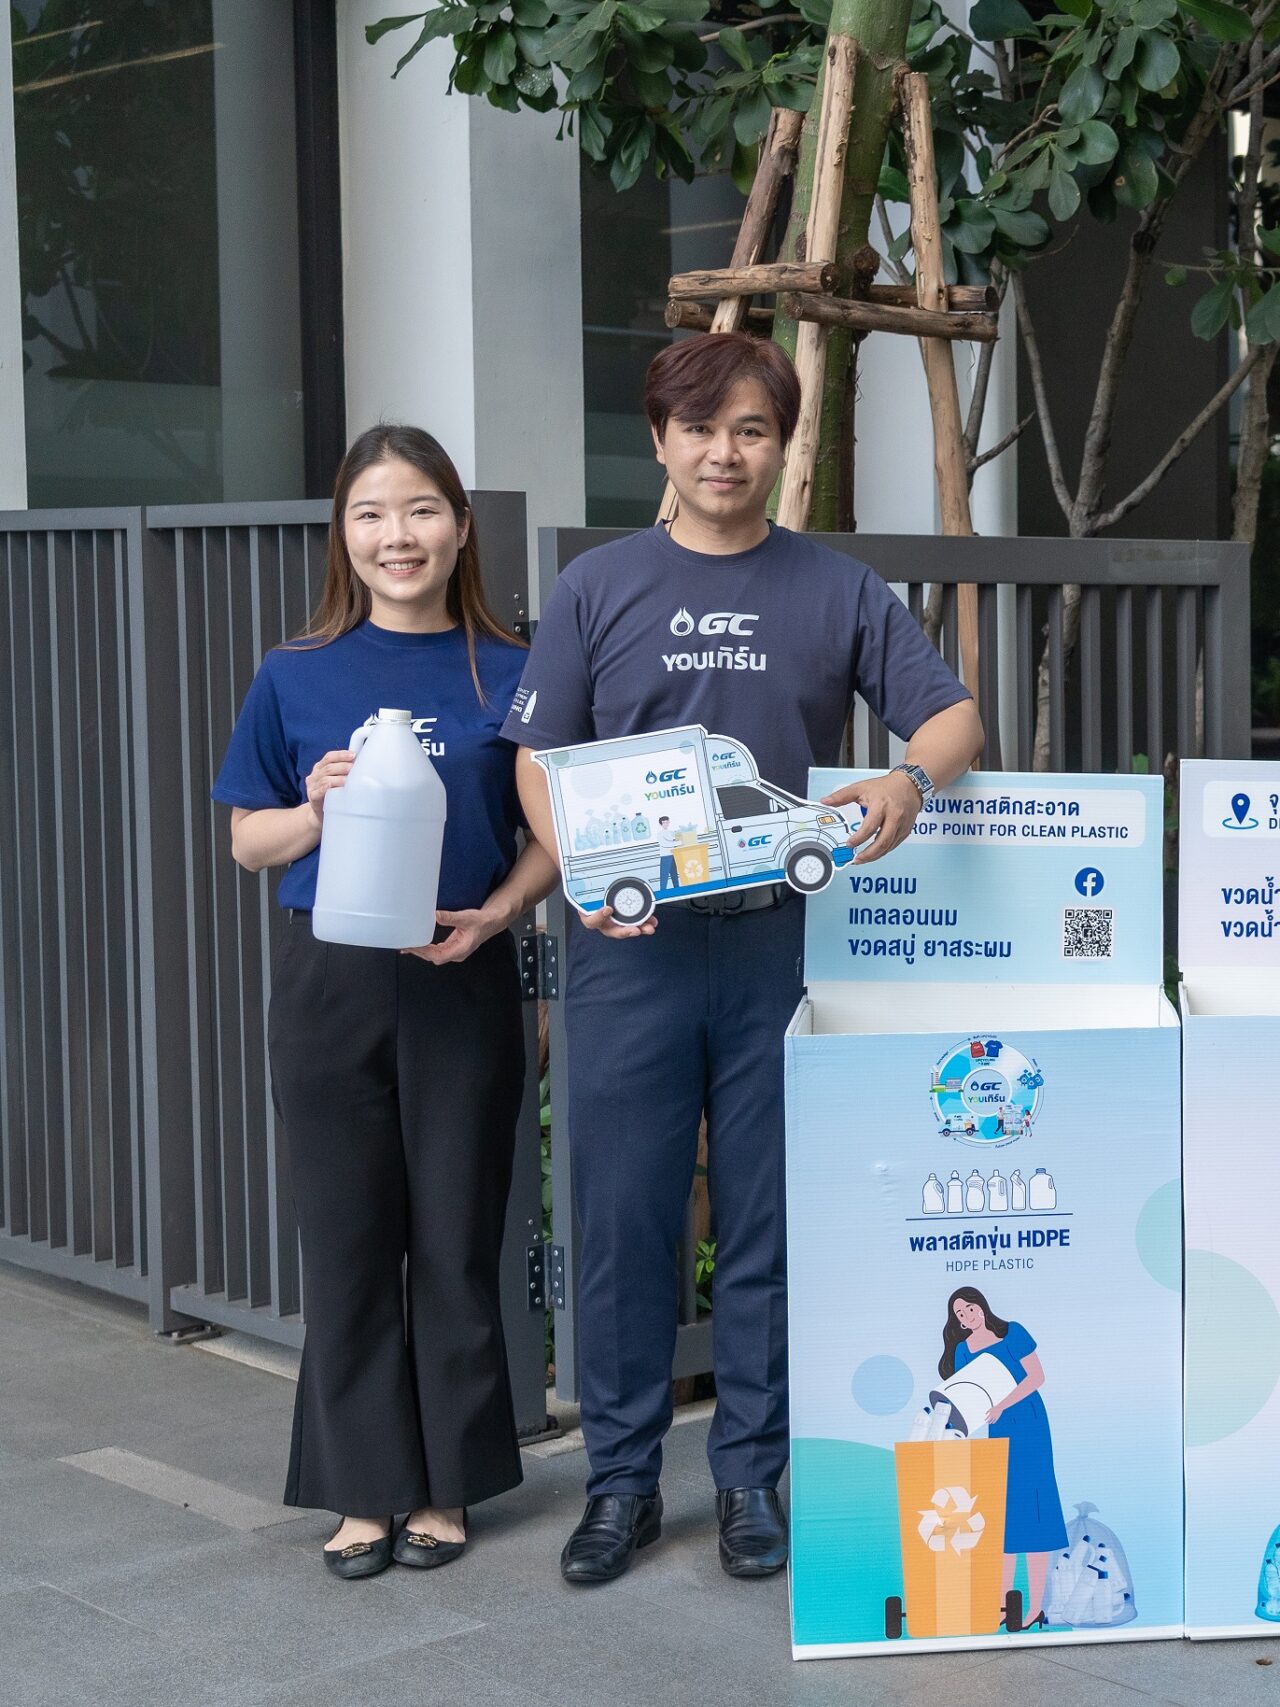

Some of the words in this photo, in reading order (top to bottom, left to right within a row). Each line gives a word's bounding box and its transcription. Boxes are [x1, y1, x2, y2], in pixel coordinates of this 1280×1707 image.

[697, 612, 760, 636] GC
[720, 751, 737, 761] GC
[659, 767, 687, 783] GC
[912, 822, 938, 836] ROP
[942, 822, 985, 836] POINT
[989, 823, 1017, 837] FOR
[1021, 824, 1066, 838] CLEAN
[1071, 825, 1129, 839] PLASTIC
[747, 833, 773, 848] GC
[849, 876, 917, 895] ขวดนม
[849, 907, 958, 926] แกลลอนนม
[848, 934, 916, 965] ขวดสบู่
[923, 938, 1012, 958] ยาสระผม
[979, 1081, 1003, 1091] GC
[909, 1225, 1012, 1256] พลาสติกขุ่น
[1017, 1228, 1071, 1249] HDPE
[945, 1259, 979, 1273] HDPE
[983, 1257, 1035, 1271] PLASTIC
